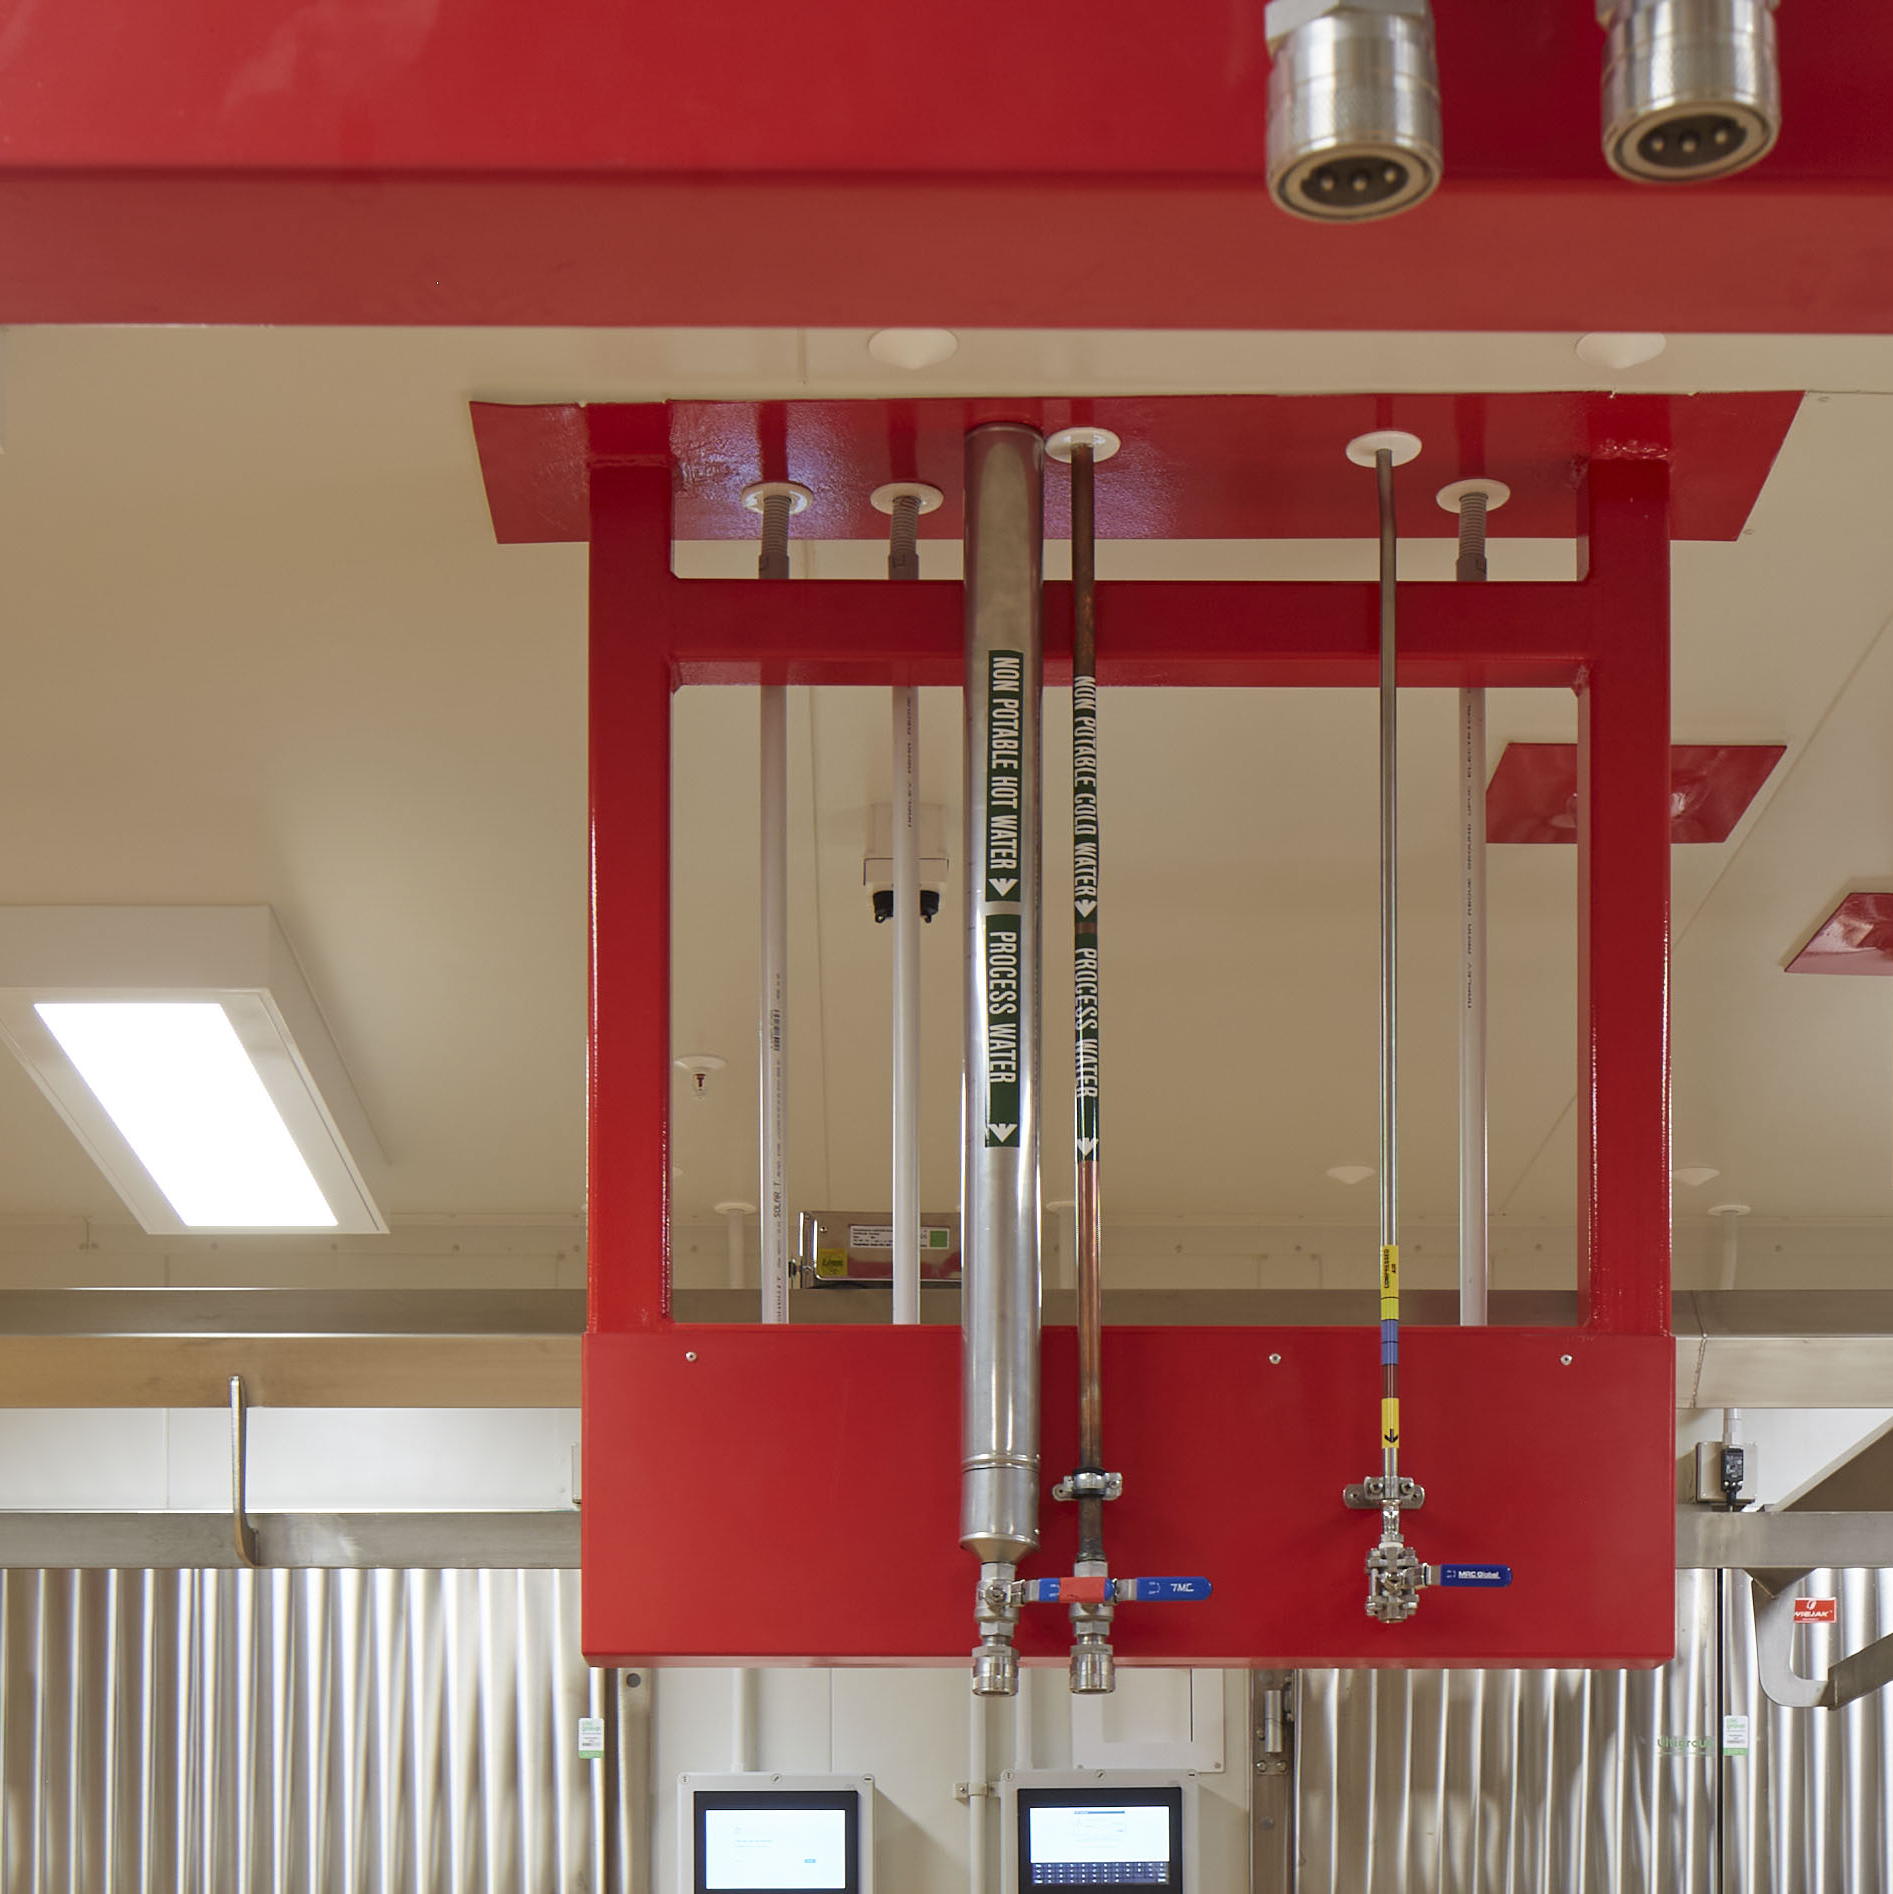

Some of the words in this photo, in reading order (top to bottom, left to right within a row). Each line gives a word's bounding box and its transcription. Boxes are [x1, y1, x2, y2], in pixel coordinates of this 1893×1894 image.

[992, 656, 1020, 692] NON
[1074, 675, 1096, 710] NON
[991, 698, 1020, 770] POTABLE
[1074, 715, 1096, 788] POTABLE
[990, 776, 1018, 809] HOT
[1074, 792, 1096, 836] COLD
[989, 814, 1017, 870] WATER
[1074, 842, 1097, 897] WATER
[989, 931, 1017, 1015] PROCESS
[1075, 947, 1098, 1030] PROCESS
[989, 1023, 1017, 1083] WATER
[1075, 1038, 1098, 1098] WATER
[773, 1191, 781, 1218] SOLAR
